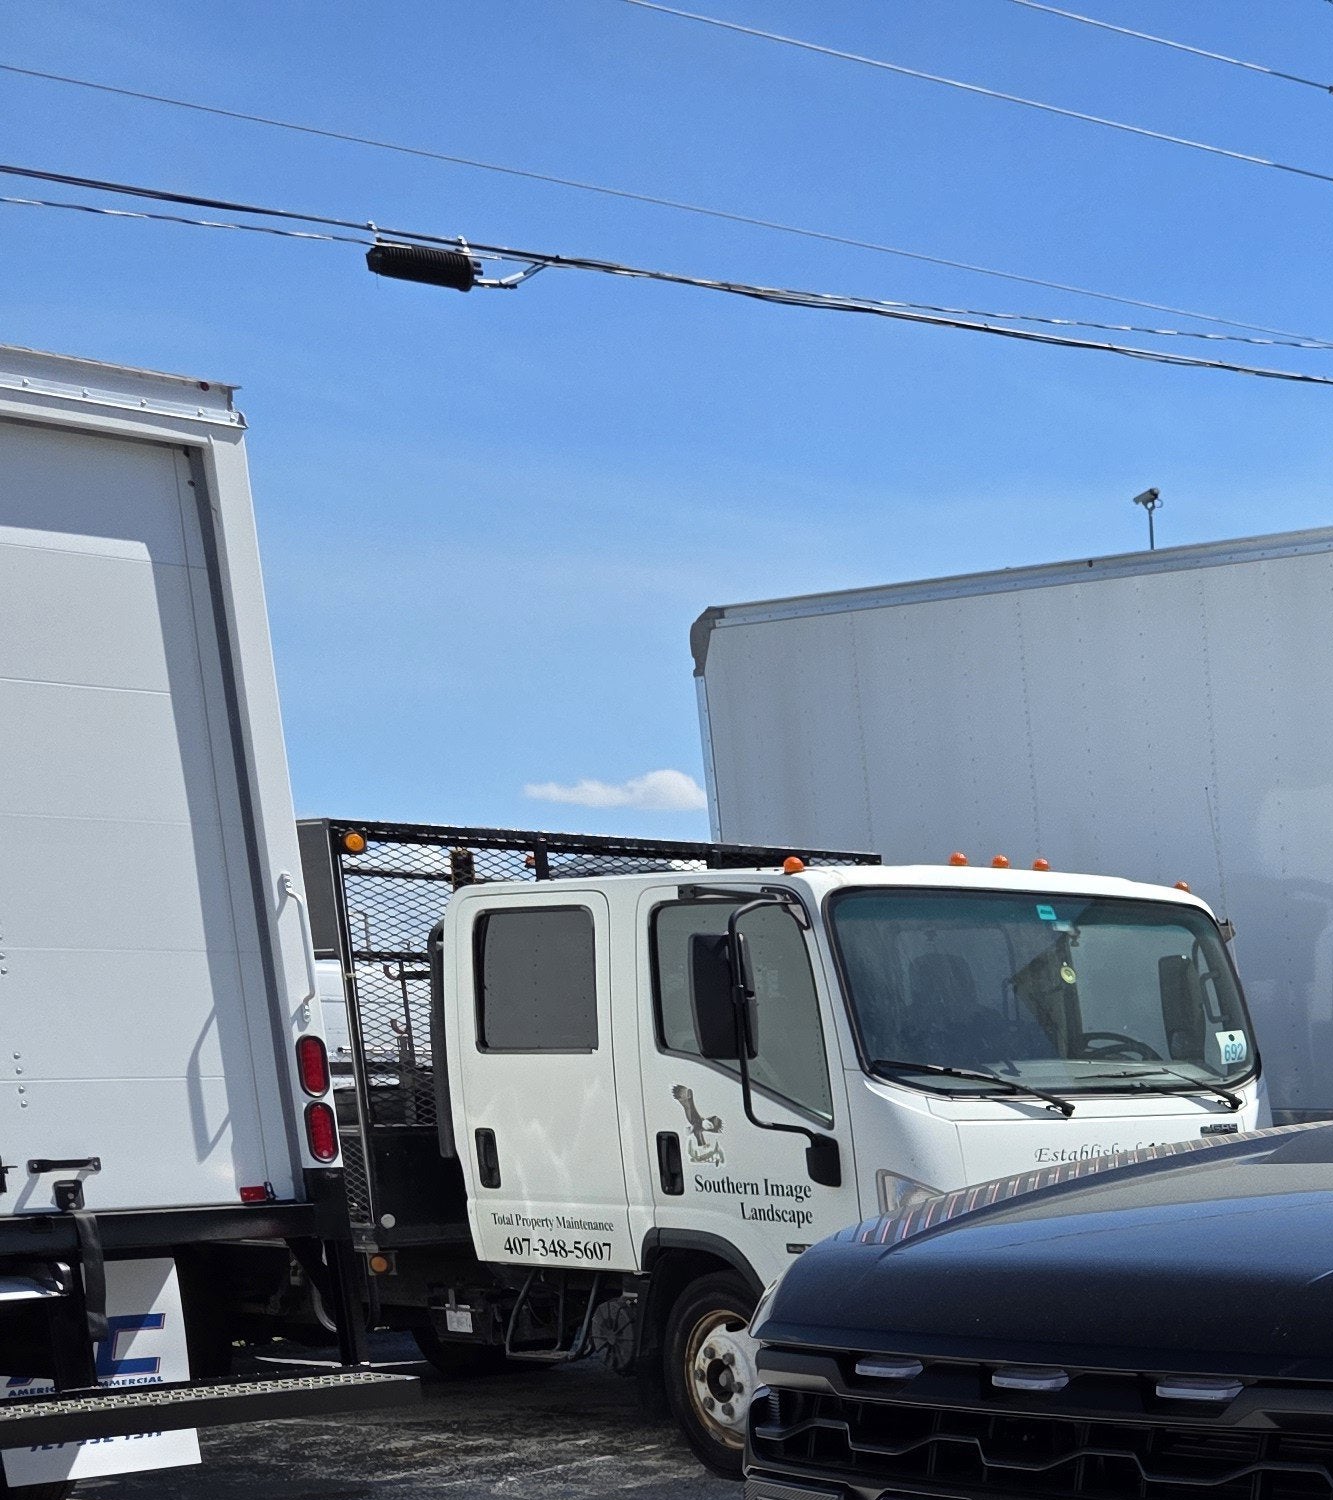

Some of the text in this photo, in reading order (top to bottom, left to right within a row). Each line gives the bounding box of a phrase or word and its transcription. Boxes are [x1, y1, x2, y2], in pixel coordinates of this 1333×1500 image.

[1225, 1043, 1243, 1061] 692
[694, 1174, 812, 1202] Southern Image
[491, 1212, 614, 1232] Total Property Maintenance
[740, 1202, 813, 1228] Landscape
[504, 1236, 612, 1261] 407-348-5607
[8, 1376, 164, 1397] AMERIC MMERCIAL
